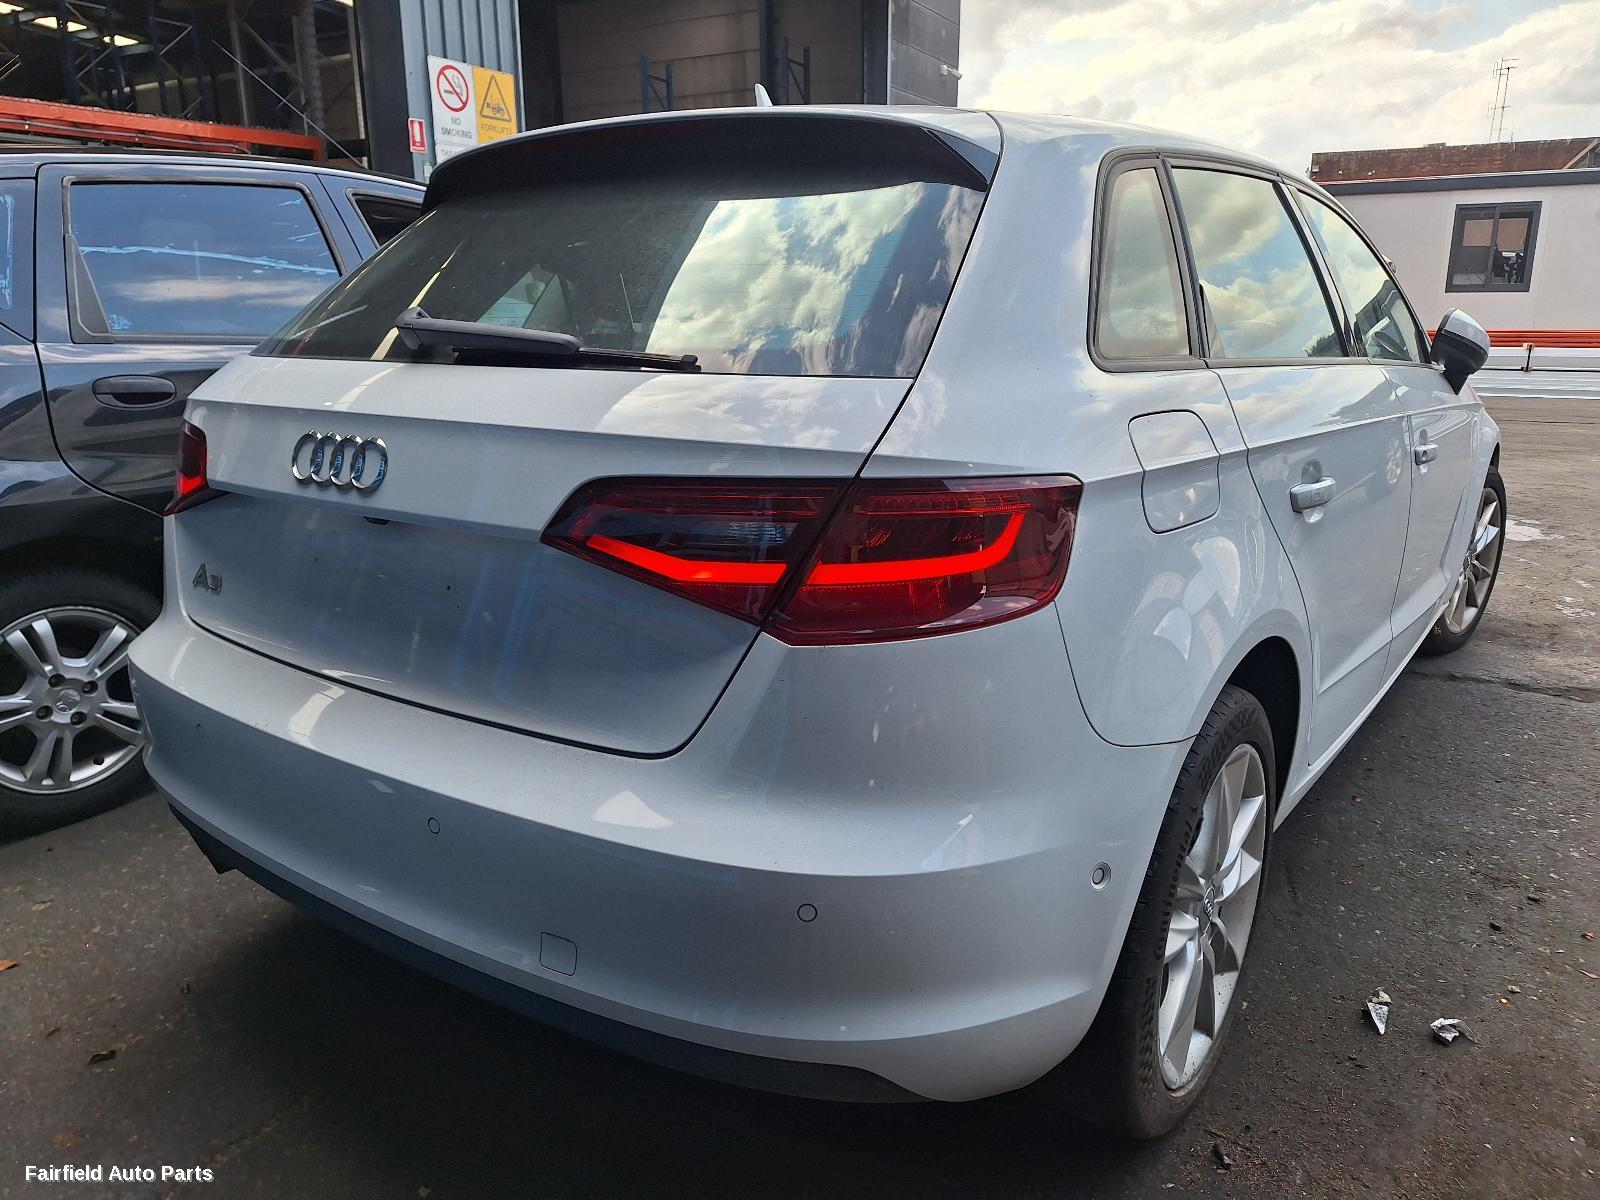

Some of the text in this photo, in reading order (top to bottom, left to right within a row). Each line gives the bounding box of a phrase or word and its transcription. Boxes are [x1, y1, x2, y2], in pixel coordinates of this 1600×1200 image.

[451, 116, 461, 126] NO
[441, 126, 472, 139] SMOKING
[192, 563, 223, 595] A3
